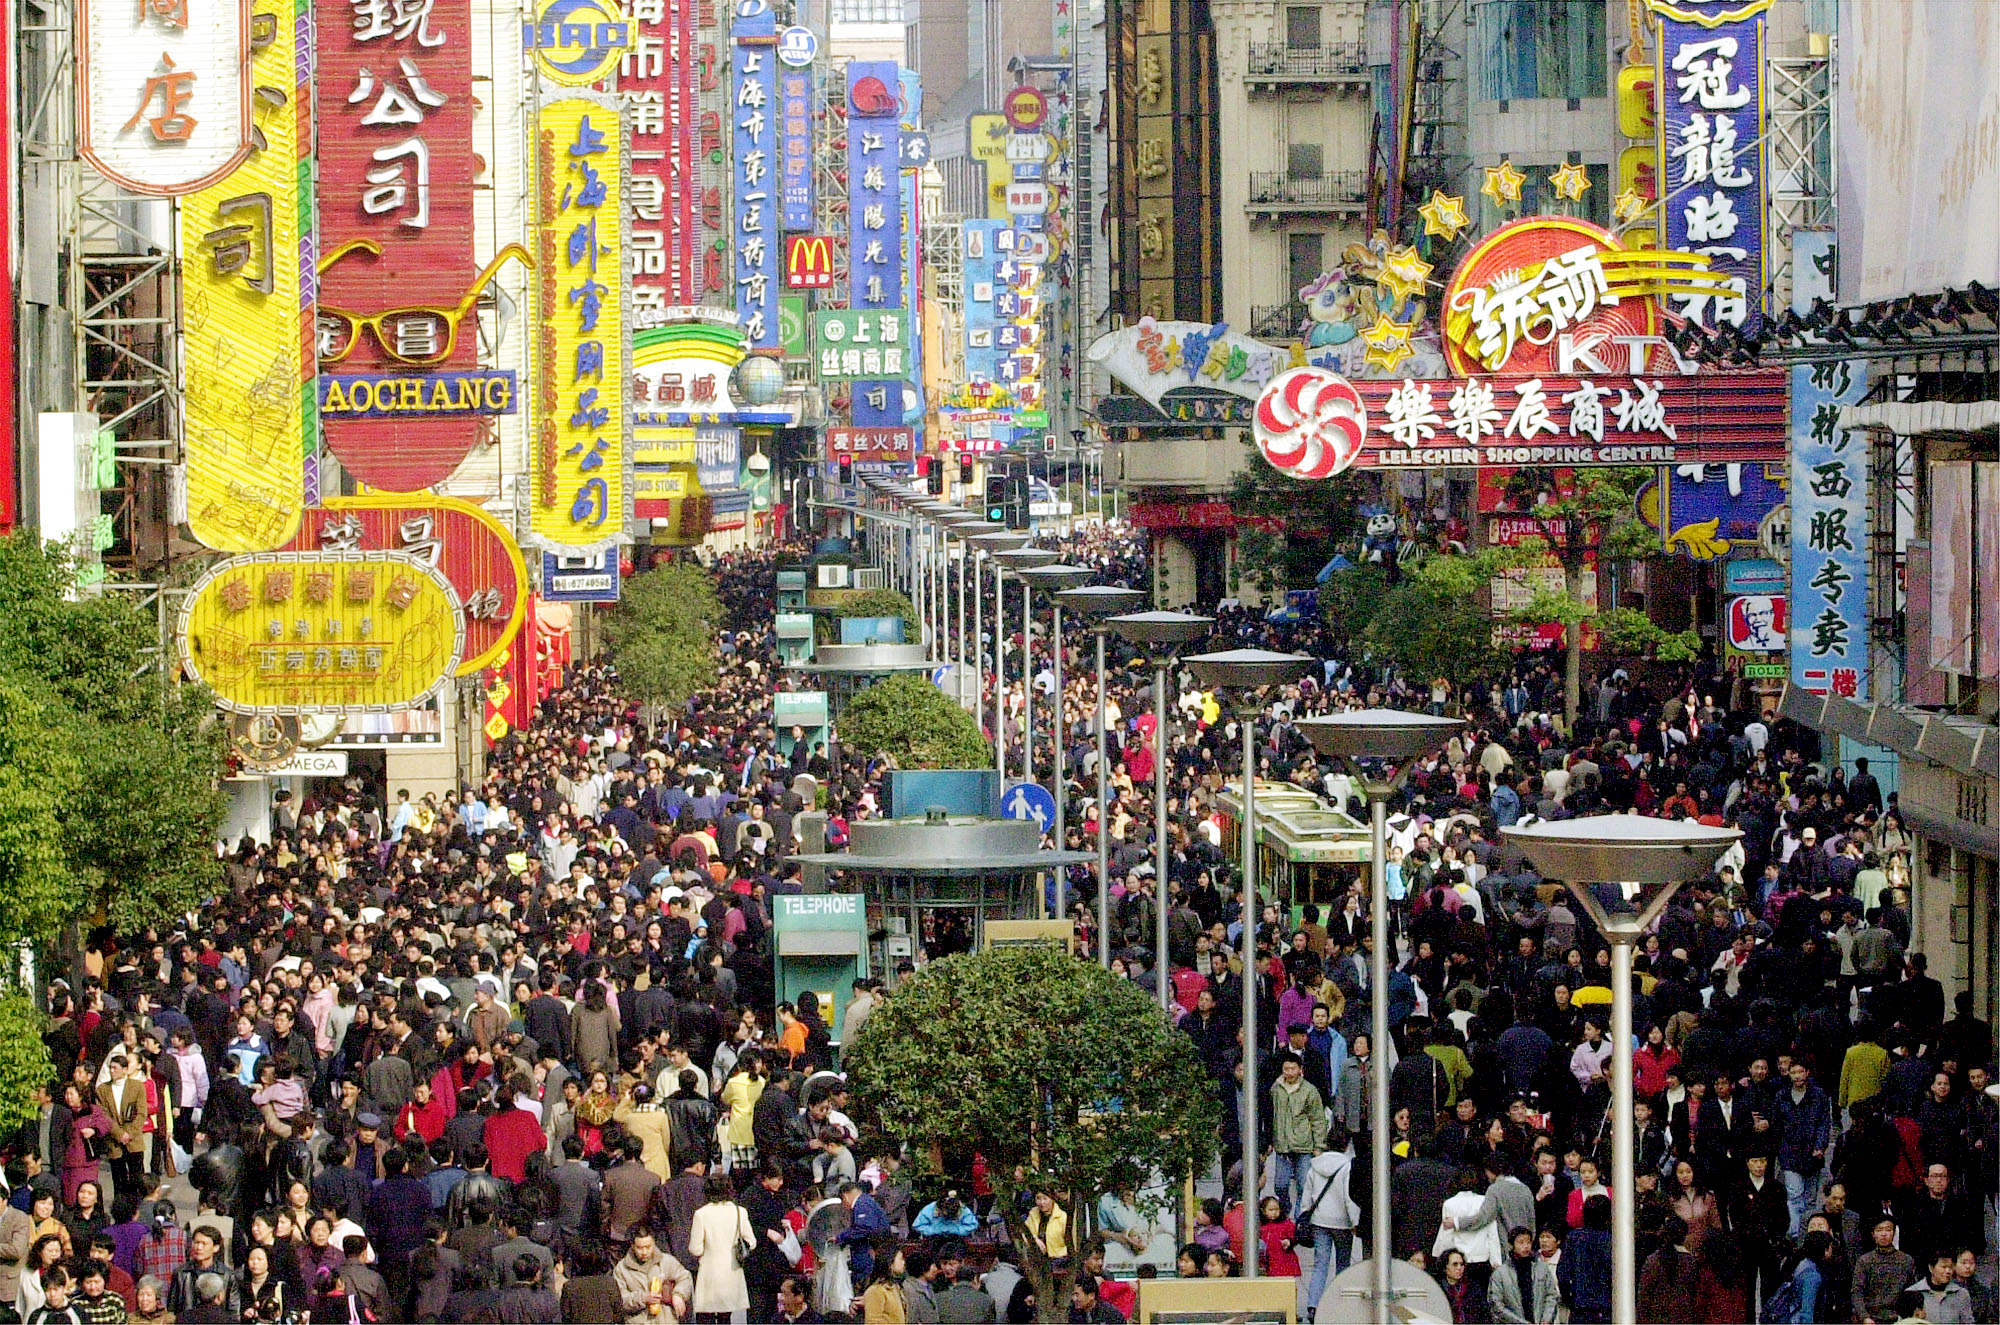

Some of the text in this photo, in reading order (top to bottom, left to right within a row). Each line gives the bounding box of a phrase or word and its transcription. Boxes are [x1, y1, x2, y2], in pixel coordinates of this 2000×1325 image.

[852, 315, 899, 343] 上海
[821, 348, 903, 376] 丝绸商厦
[833, 432, 910, 451] 爱丝火锅
[1379, 445, 1676, 465] LELECHEN SHOPPING CENTRE
[1804, 668, 1858, 698] 二楼
[275, 757, 338, 771] MEGA
[783, 896, 857, 915] TELEPHONE
